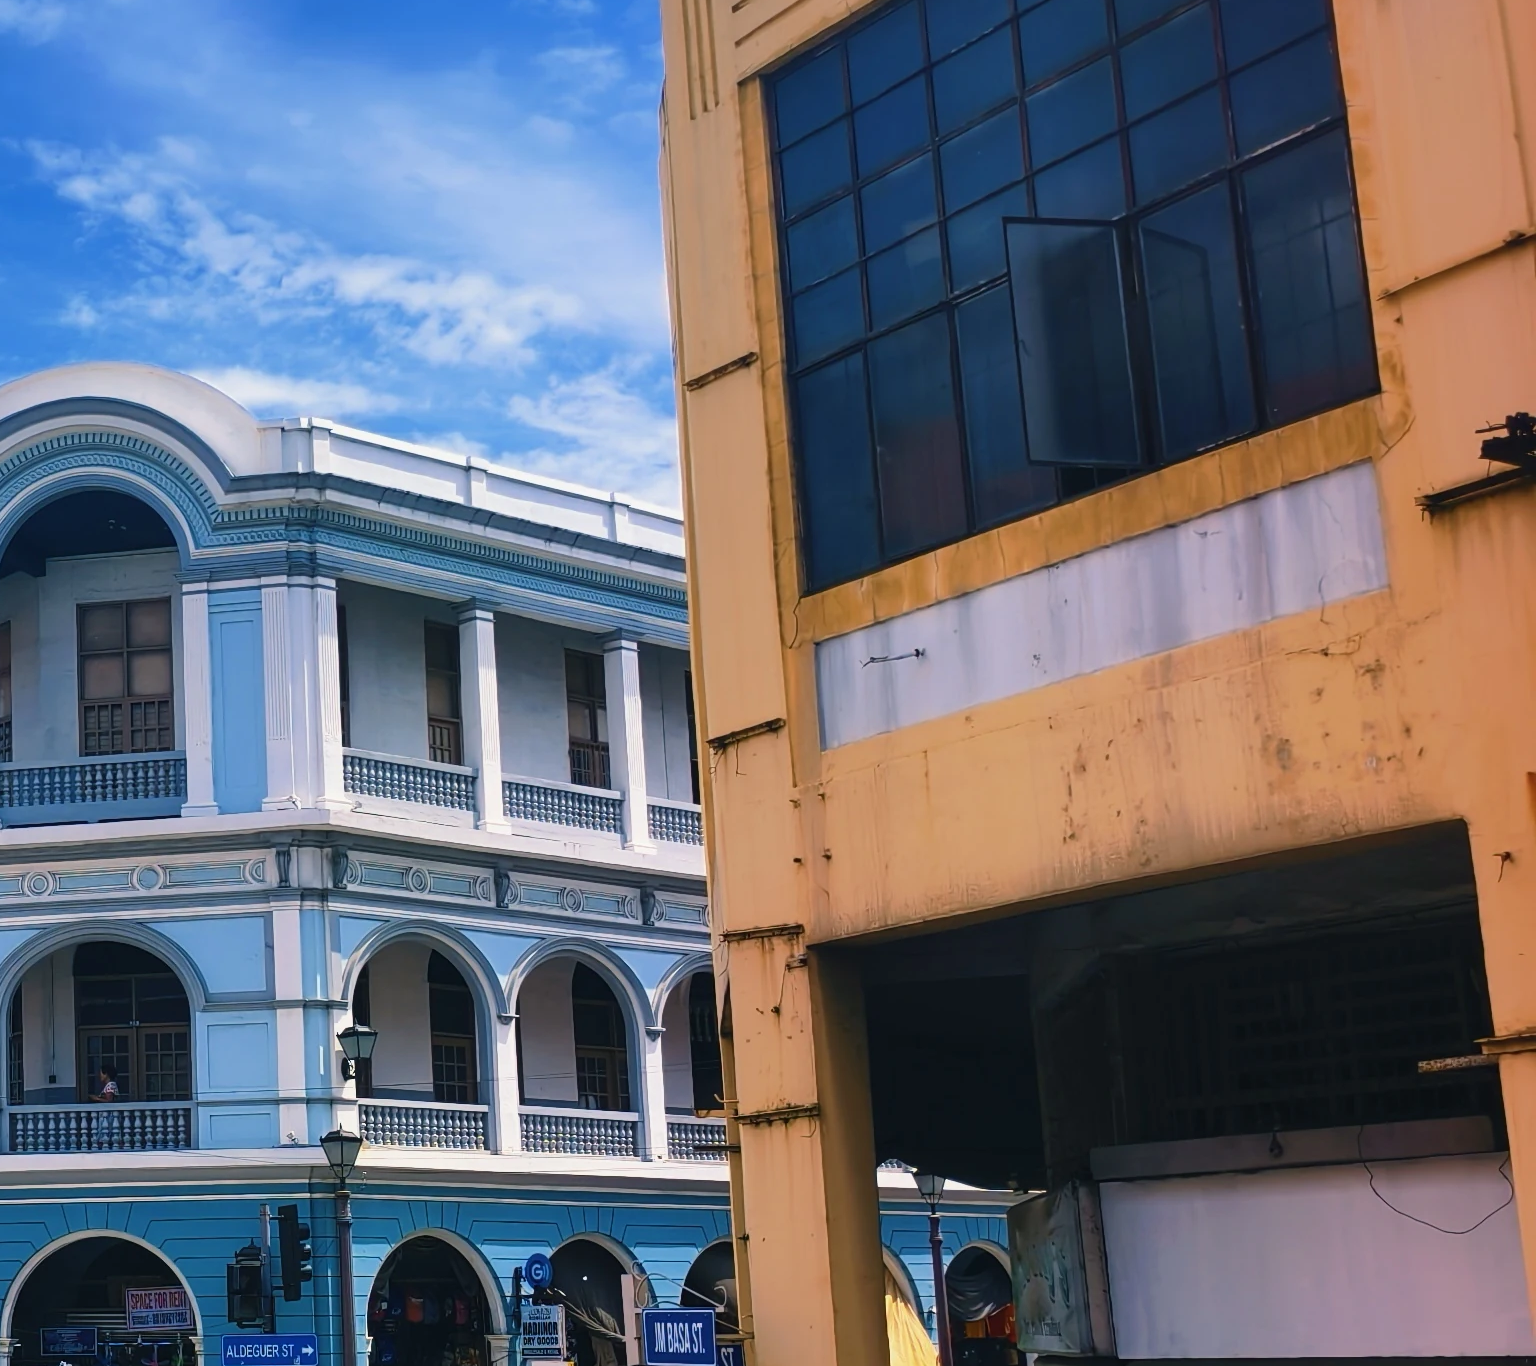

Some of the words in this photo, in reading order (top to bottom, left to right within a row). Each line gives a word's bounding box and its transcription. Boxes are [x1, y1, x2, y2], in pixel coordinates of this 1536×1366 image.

[130, 1293, 153, 1310] SPACE
[154, 1292, 168, 1309] FOR
[523, 1337, 536, 1346] DRY
[537, 1336, 559, 1346] GOODS
[654, 1322, 666, 1353] JM
[667, 1323, 691, 1353] BASA
[692, 1323, 706, 1354] ST.
[226, 1344, 280, 1358] ALDEGUER
[281, 1344, 295, 1357] ST
